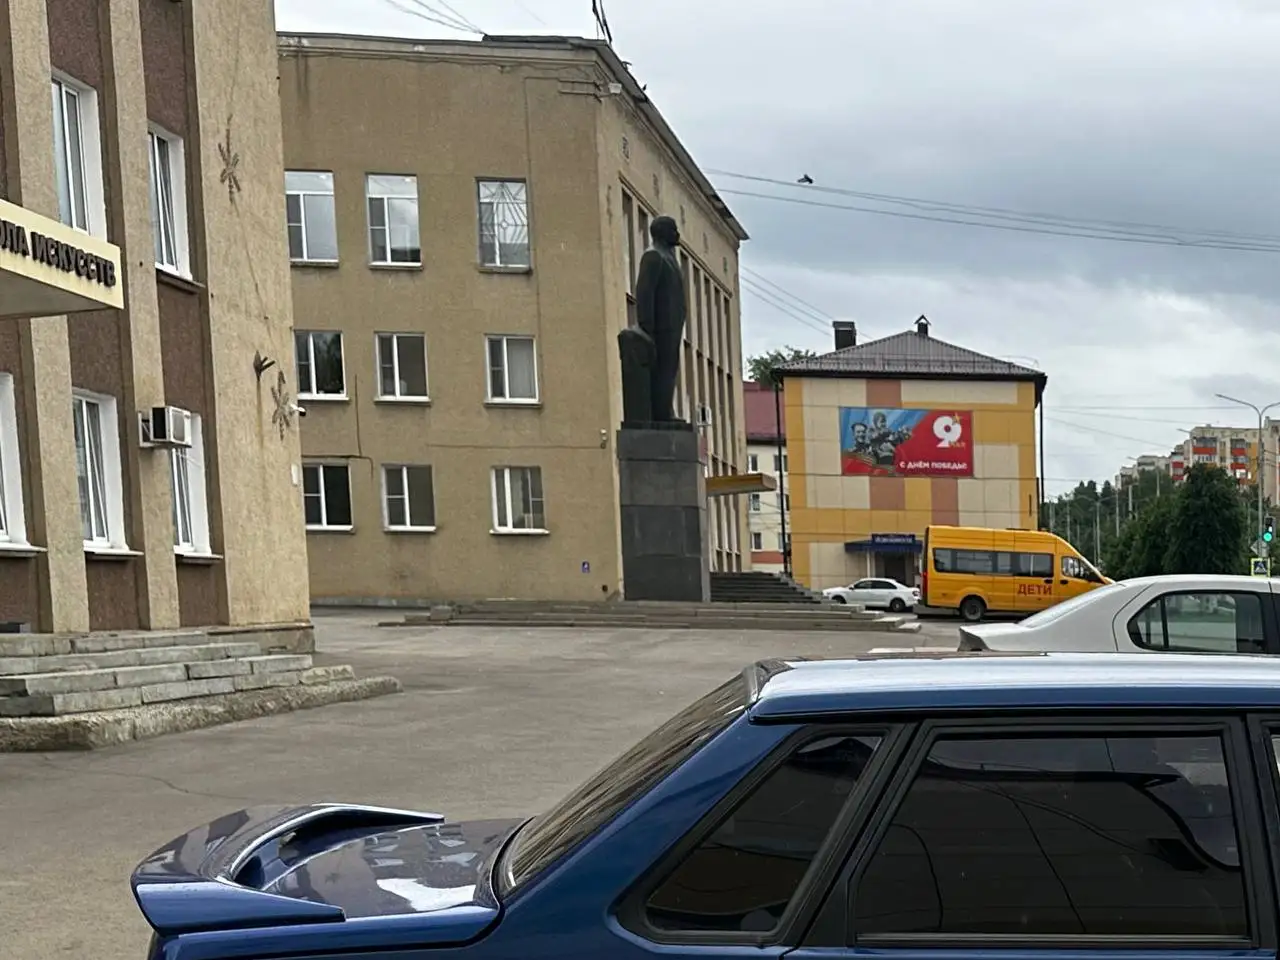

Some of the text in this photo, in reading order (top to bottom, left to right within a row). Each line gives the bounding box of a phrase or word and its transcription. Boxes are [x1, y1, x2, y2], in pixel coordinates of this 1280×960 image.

[30, 231, 116, 287] ИСКУССТВ
[933, 416, 962, 448] 9
[1017, 584, 1052, 596] ДЕТИ
